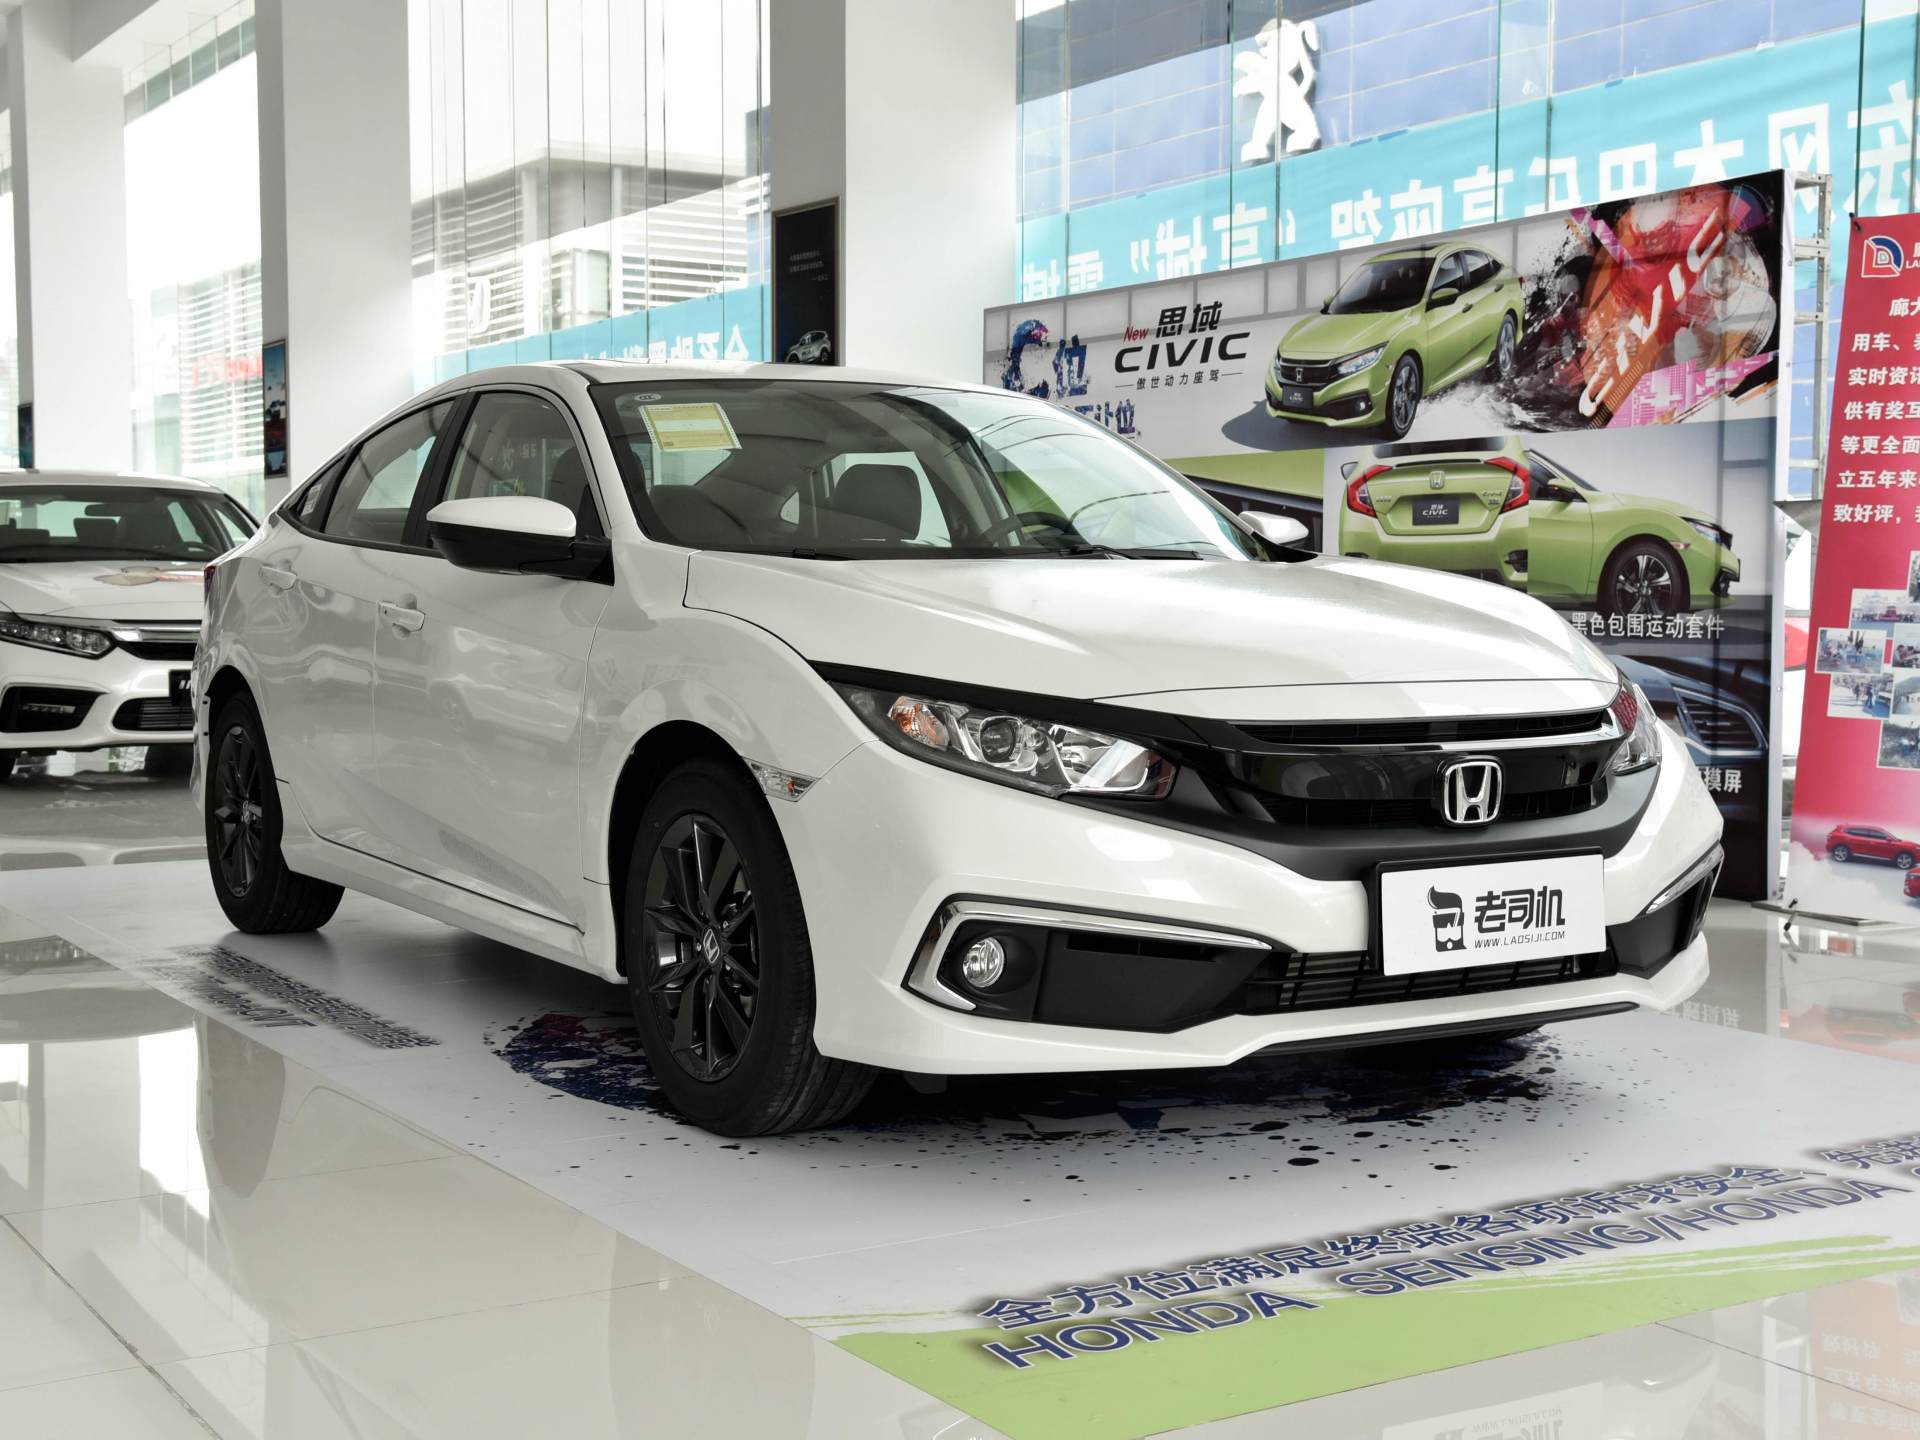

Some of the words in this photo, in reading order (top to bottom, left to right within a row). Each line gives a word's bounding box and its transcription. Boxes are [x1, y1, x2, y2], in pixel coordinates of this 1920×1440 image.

[1123, 324, 1150, 344] New
[1156, 300, 1223, 338] 思域
[1115, 332, 1251, 373] CIVIC
[1136, 369, 1220, 390] 傲世动力座驾
[1840, 435, 1920, 455] 等更全面
[1422, 509, 1449, 517] CIVIC
[1572, 612, 1725, 640] 黑色包围运动套件
[1474, 885, 1567, 934] 老司机
[1474, 931, 1567, 949] WWW.LAOSIJI.COM
[982, 1290, 1318, 1369] HONDA
[1334, 1179, 1916, 1296] SENSING/HONDA
